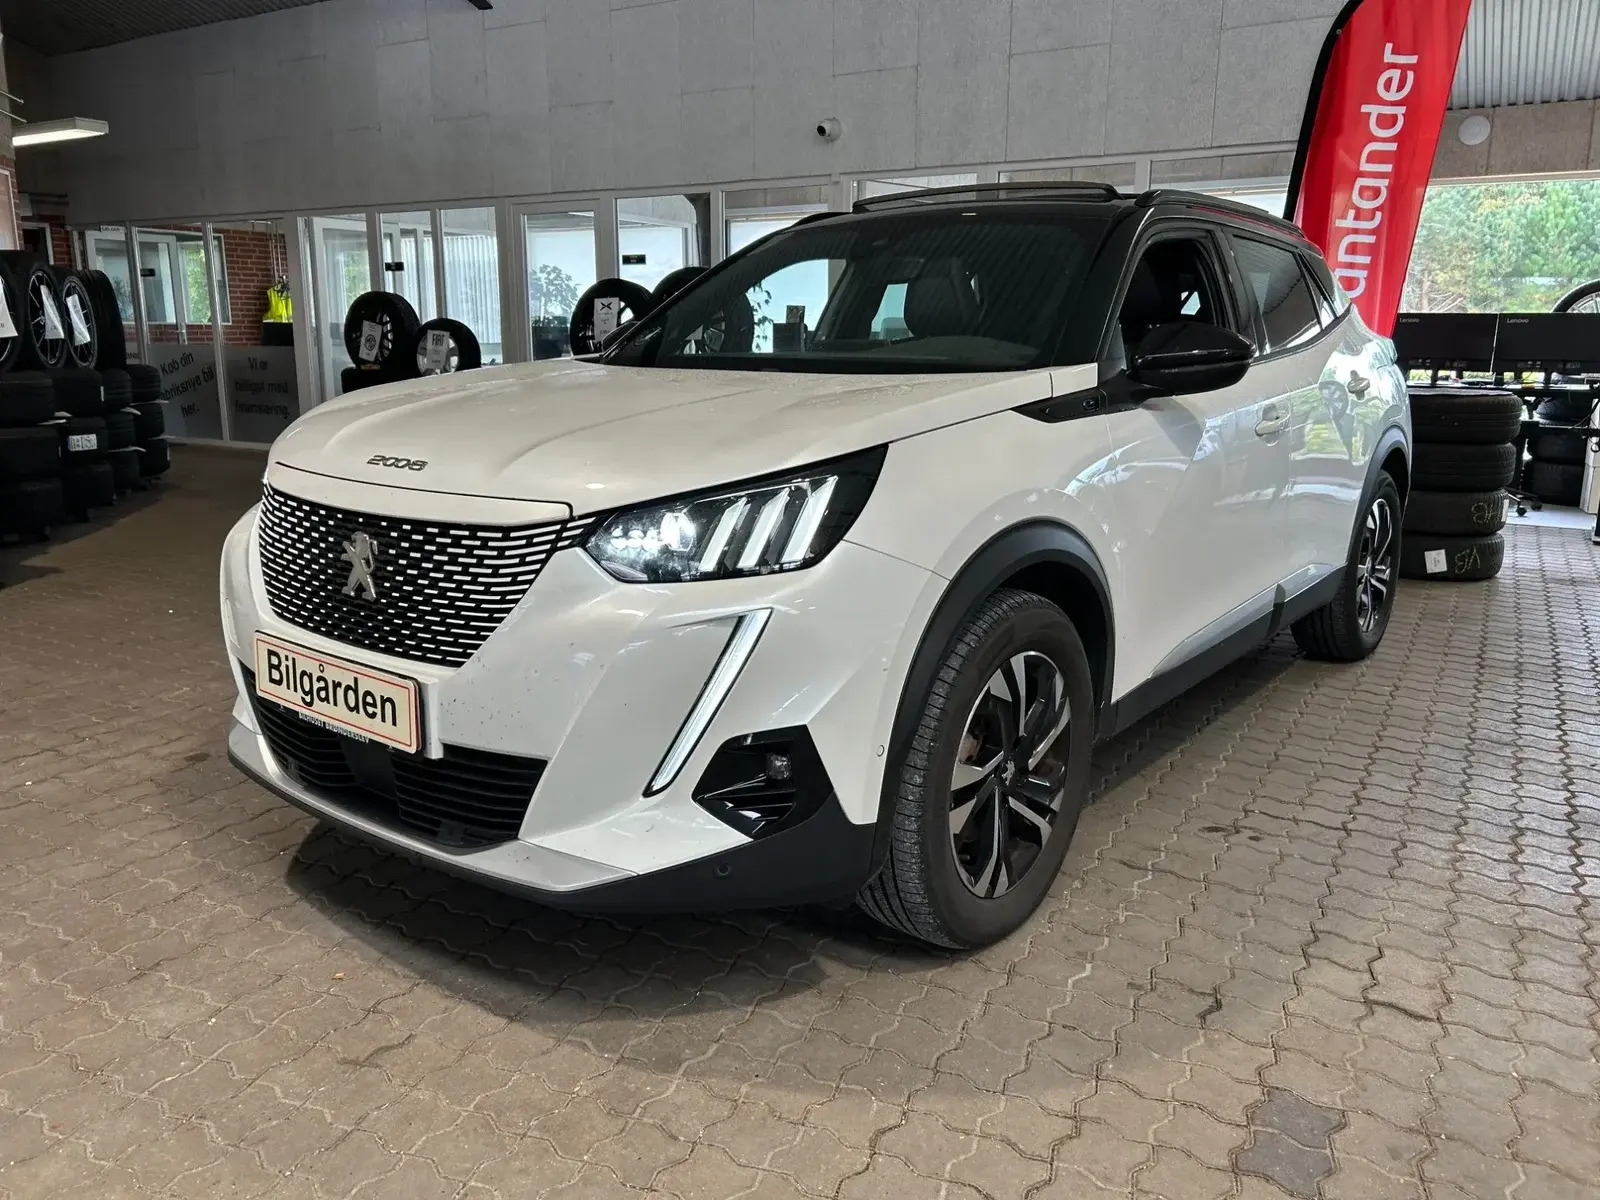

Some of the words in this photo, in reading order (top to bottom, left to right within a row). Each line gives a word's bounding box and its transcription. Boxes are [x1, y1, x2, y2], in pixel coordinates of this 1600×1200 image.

[1331, 42, 1419, 298] antander
[432, 333, 445, 346] FIAT
[160, 358, 179, 376] Køb
[180, 352, 194, 367] din
[160, 375, 202, 401] abriksnye
[202, 366, 214, 382] bil
[366, 455, 428, 471] 2008
[266, 648, 397, 727] Bilgården
[298, 711, 325, 729] BILHUSET
